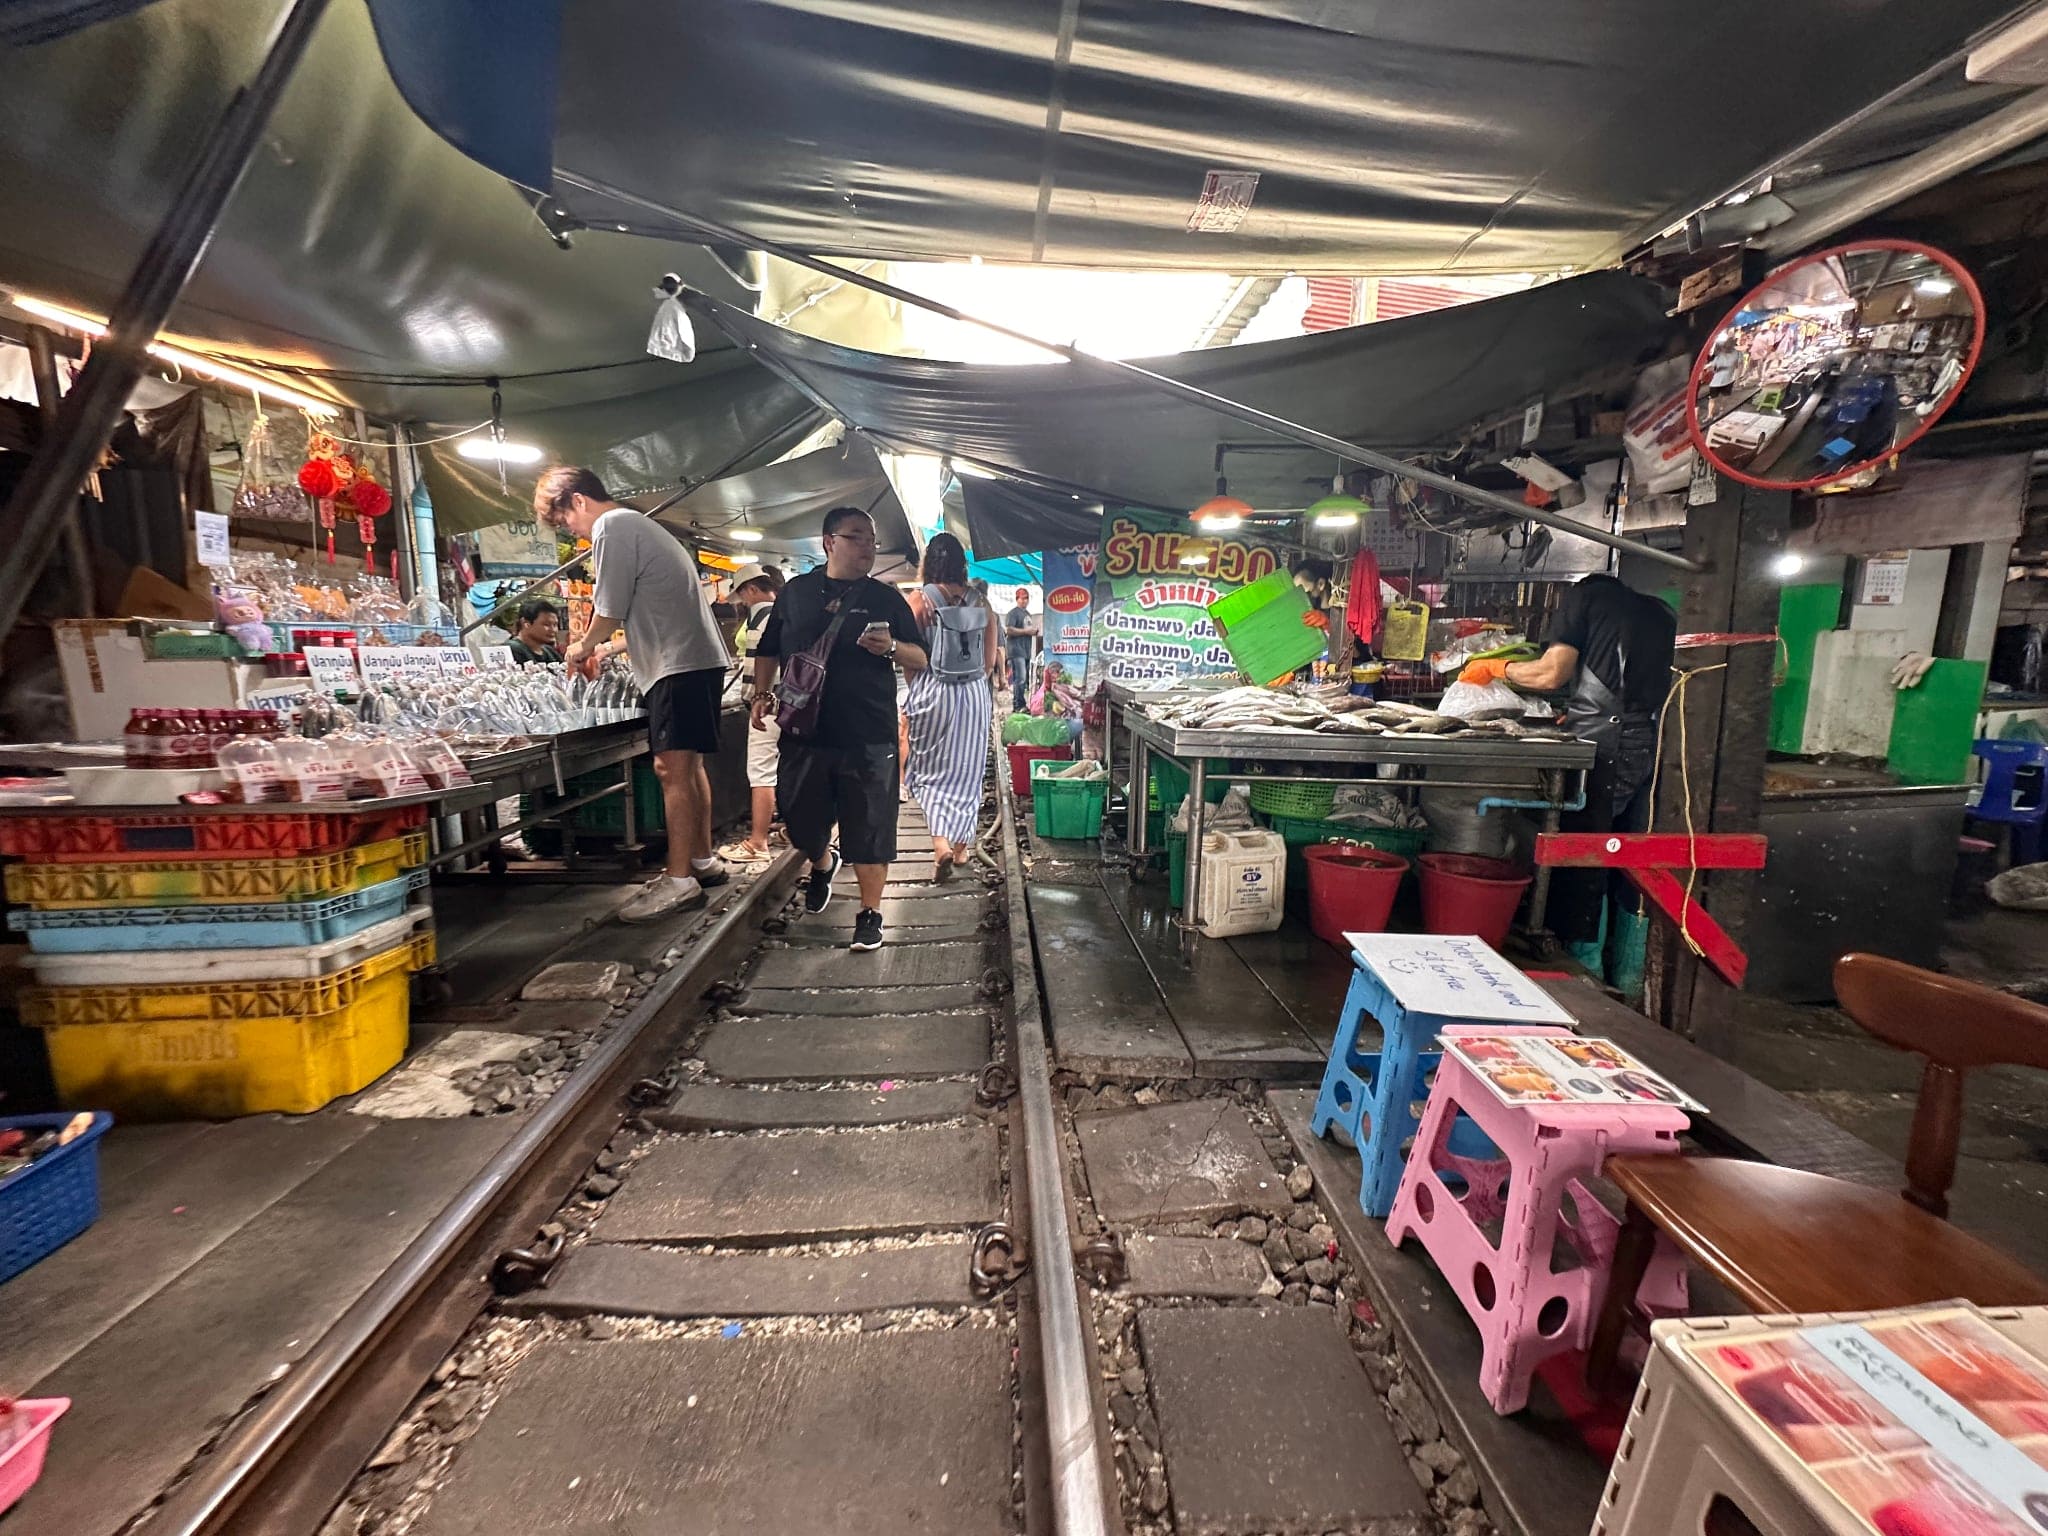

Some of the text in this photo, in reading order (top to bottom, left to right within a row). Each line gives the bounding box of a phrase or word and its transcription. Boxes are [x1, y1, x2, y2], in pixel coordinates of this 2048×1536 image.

[1106, 611, 1183, 634] ปลากะพง
[1102, 637, 1190, 660] ปลาโทงเทง
